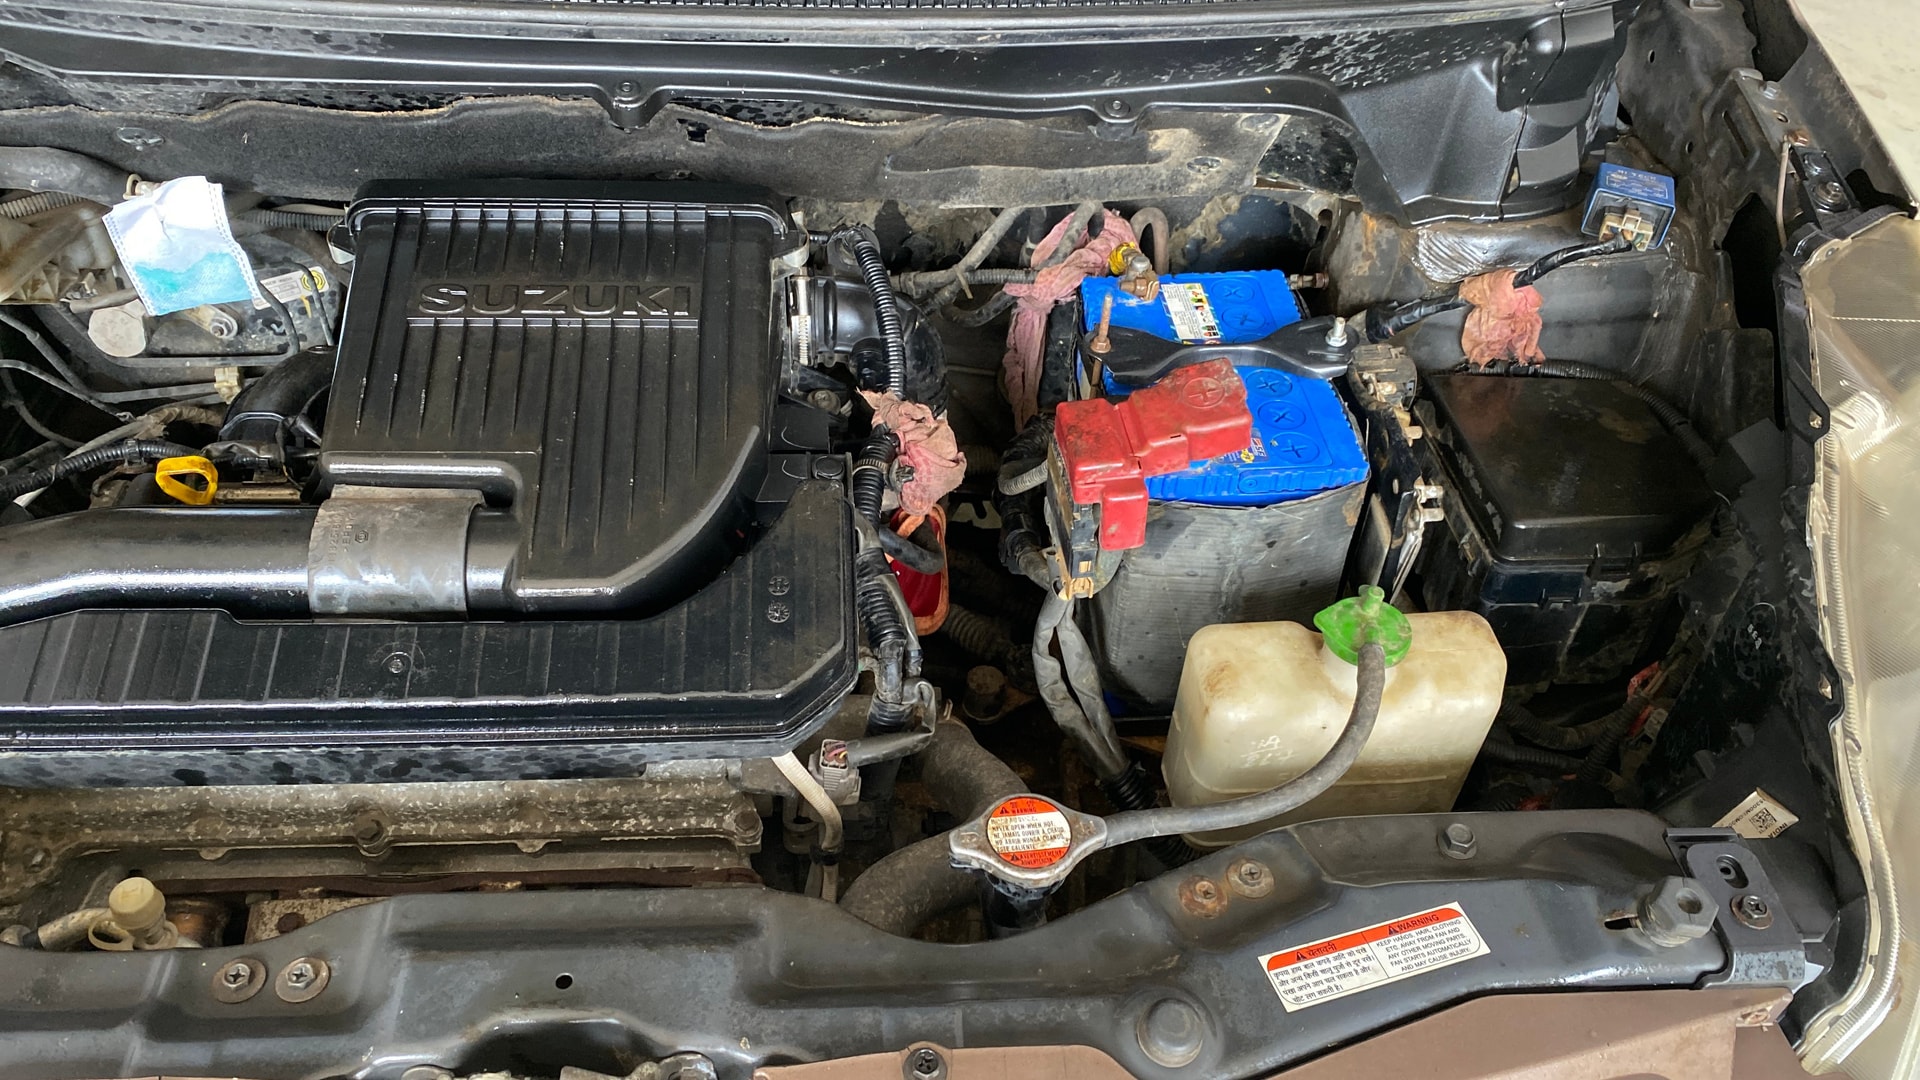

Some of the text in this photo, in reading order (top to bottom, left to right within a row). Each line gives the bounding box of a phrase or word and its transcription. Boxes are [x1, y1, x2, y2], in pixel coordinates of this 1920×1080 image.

[418, 283, 691, 316] SUZUKI
[1768, 822, 1788, 839] INDIA
[1376, 938, 1393, 948] KEEP
[1431, 918, 1462, 932] CLOTHING
[1398, 914, 1440, 931] WARNING
[1400, 939, 1417, 949] AWAY
[1417, 934, 1435, 943] FROM
[1435, 930, 1448, 938] FAN
[1447, 926, 1460, 936] AND
[1388, 951, 1400, 960] ANY
[1400, 946, 1421, 957] OTHER
[1421, 938, 1446, 951] MOVING
[1390, 938, 1472, 968] FAN STARTS AUTOMATICALLY
[1401, 964, 1414, 973] AND
[1414, 958, 1427, 968] MAY
[1428, 954, 1449, 965] CAUSE
